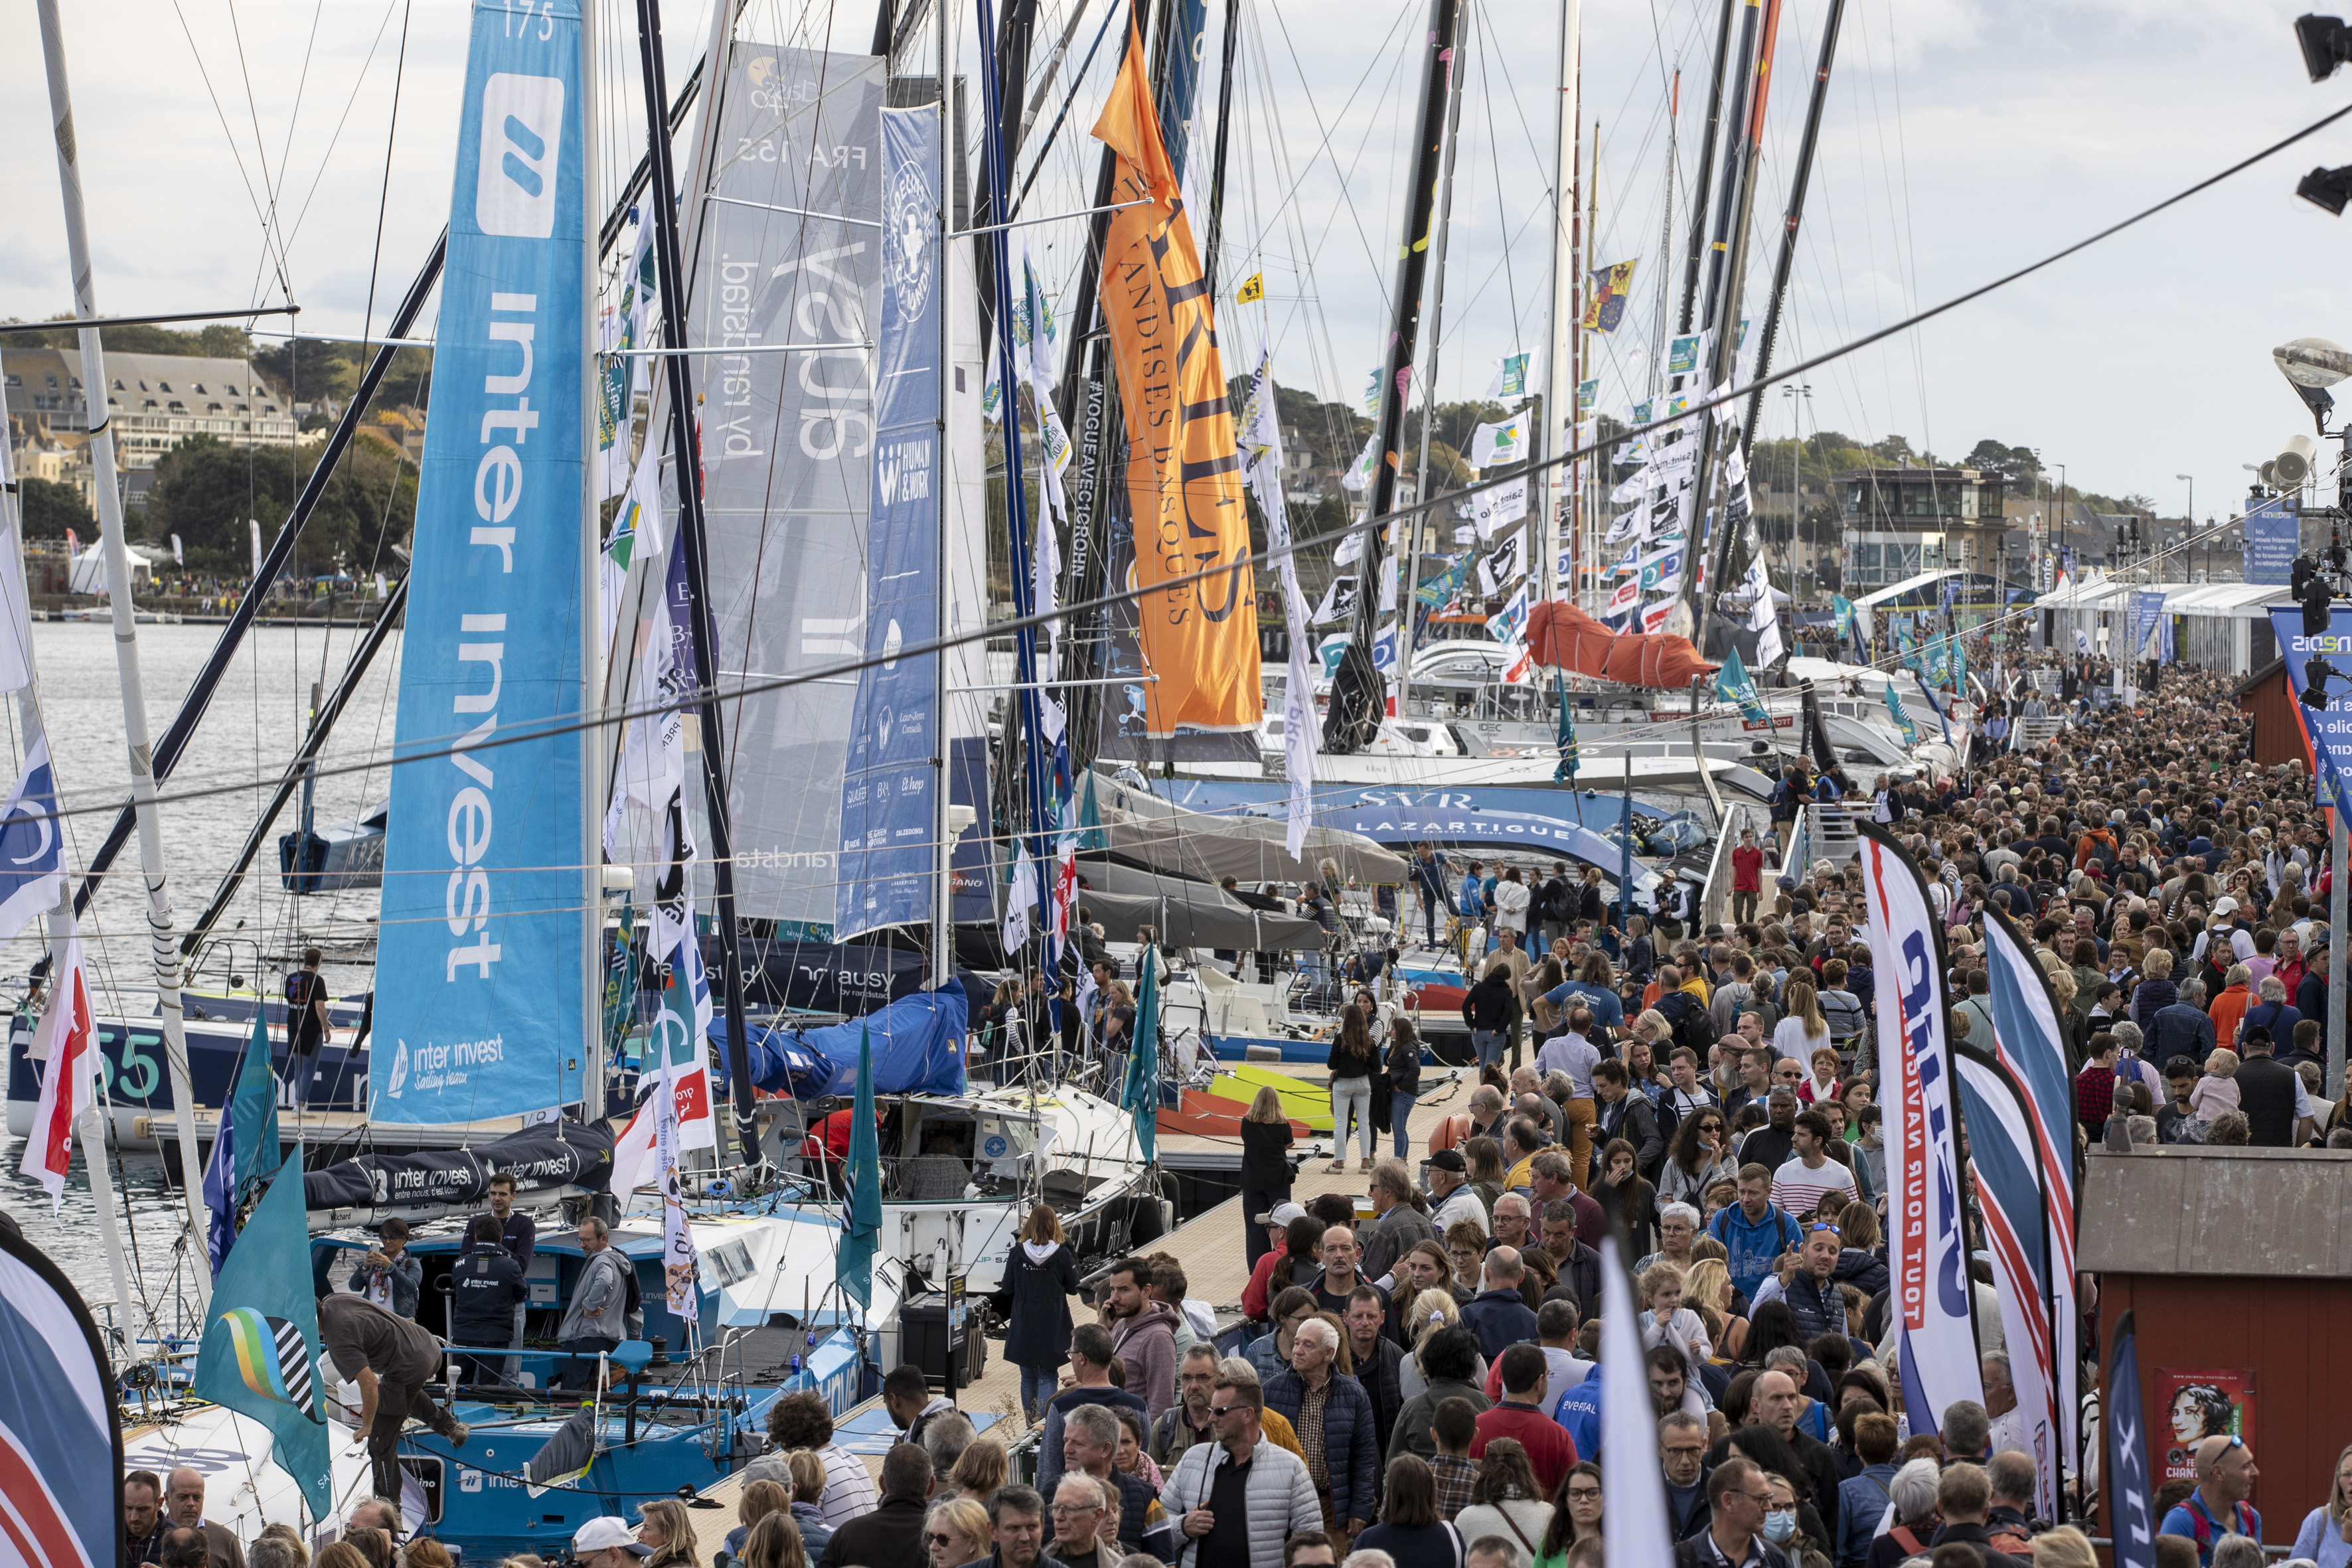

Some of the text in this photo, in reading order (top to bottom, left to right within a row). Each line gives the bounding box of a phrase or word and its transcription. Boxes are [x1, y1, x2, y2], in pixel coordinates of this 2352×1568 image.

[504, 0, 554, 41] 175
[1152, 444, 1192, 625] BASQUES
[1478, 723, 1502, 732] IDEC
[896, 827, 924, 837] CALZEDONIA
[1355, 821, 1570, 841] LAZARTIGUE
[837, 968, 897, 992] ausy
[840, 988, 849, 997] by
[1583, 992, 1601, 1002] SAILING
[413, 1032, 505, 1072] inter invest
[445, 1069, 468, 1087] team
[531, 1152, 571, 1176] invest
[394, 1166, 473, 1190] inter invest
[394, 1190, 411, 1200] entre
[412, 1188, 431, 1198] nous,
[431, 1186, 444, 1196] c'est
